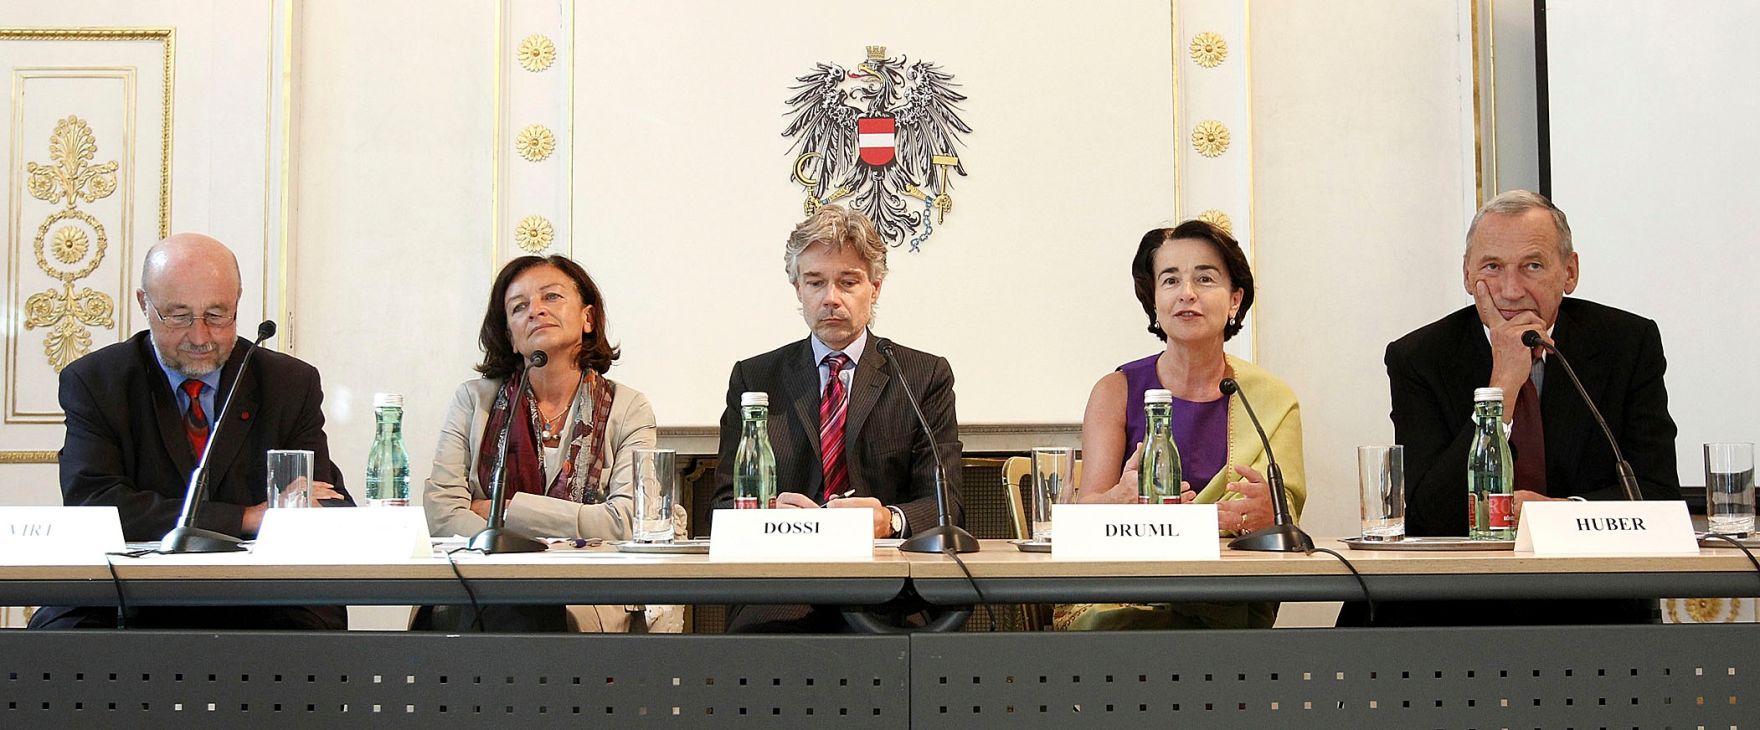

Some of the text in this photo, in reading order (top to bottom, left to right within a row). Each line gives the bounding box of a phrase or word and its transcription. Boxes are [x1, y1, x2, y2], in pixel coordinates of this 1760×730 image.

[764, 521, 820, 534] DOSSI
[1105, 523, 1180, 537] DRUML
[1576, 517, 1647, 531] HUBER
